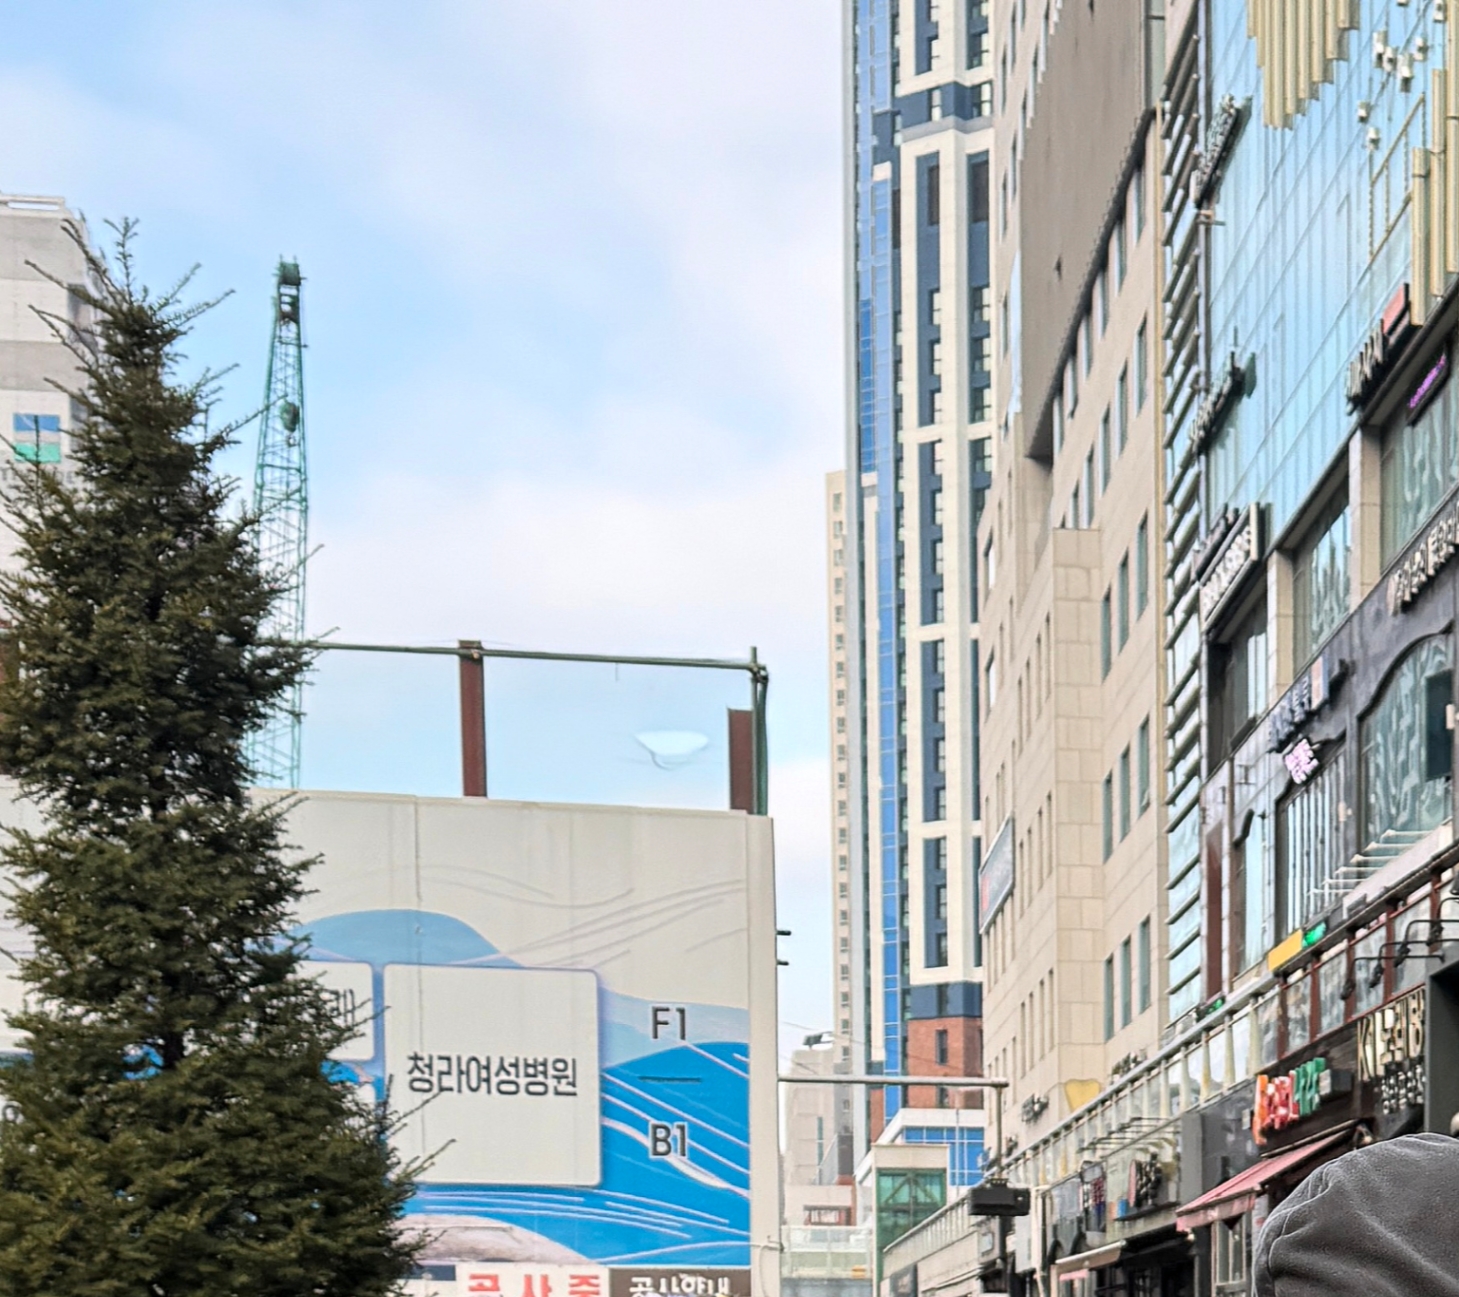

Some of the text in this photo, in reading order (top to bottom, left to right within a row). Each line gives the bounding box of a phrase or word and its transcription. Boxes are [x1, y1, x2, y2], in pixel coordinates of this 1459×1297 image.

[650, 1006, 688, 1041] F1
[406, 1050, 579, 1099] 청라여성병원
[649, 1123, 688, 1158] B1
